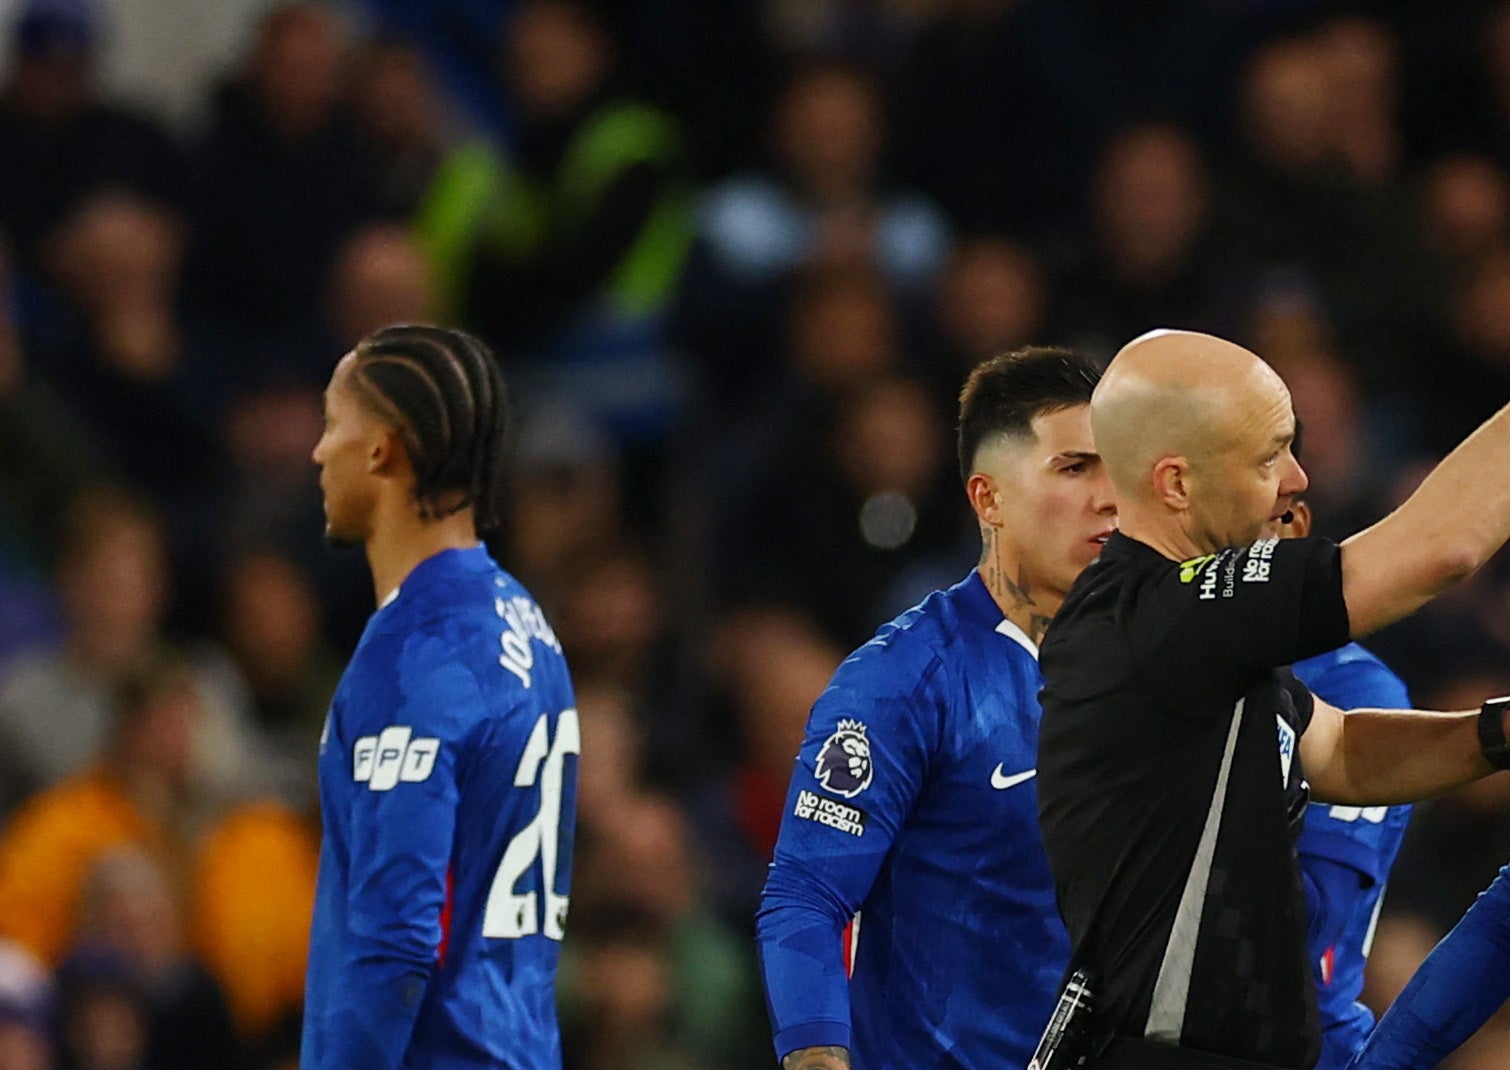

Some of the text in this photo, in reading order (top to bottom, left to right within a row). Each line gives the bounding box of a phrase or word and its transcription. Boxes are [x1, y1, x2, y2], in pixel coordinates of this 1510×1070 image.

[794, 803, 865, 837] for racism
[799, 790, 861, 823] No room
